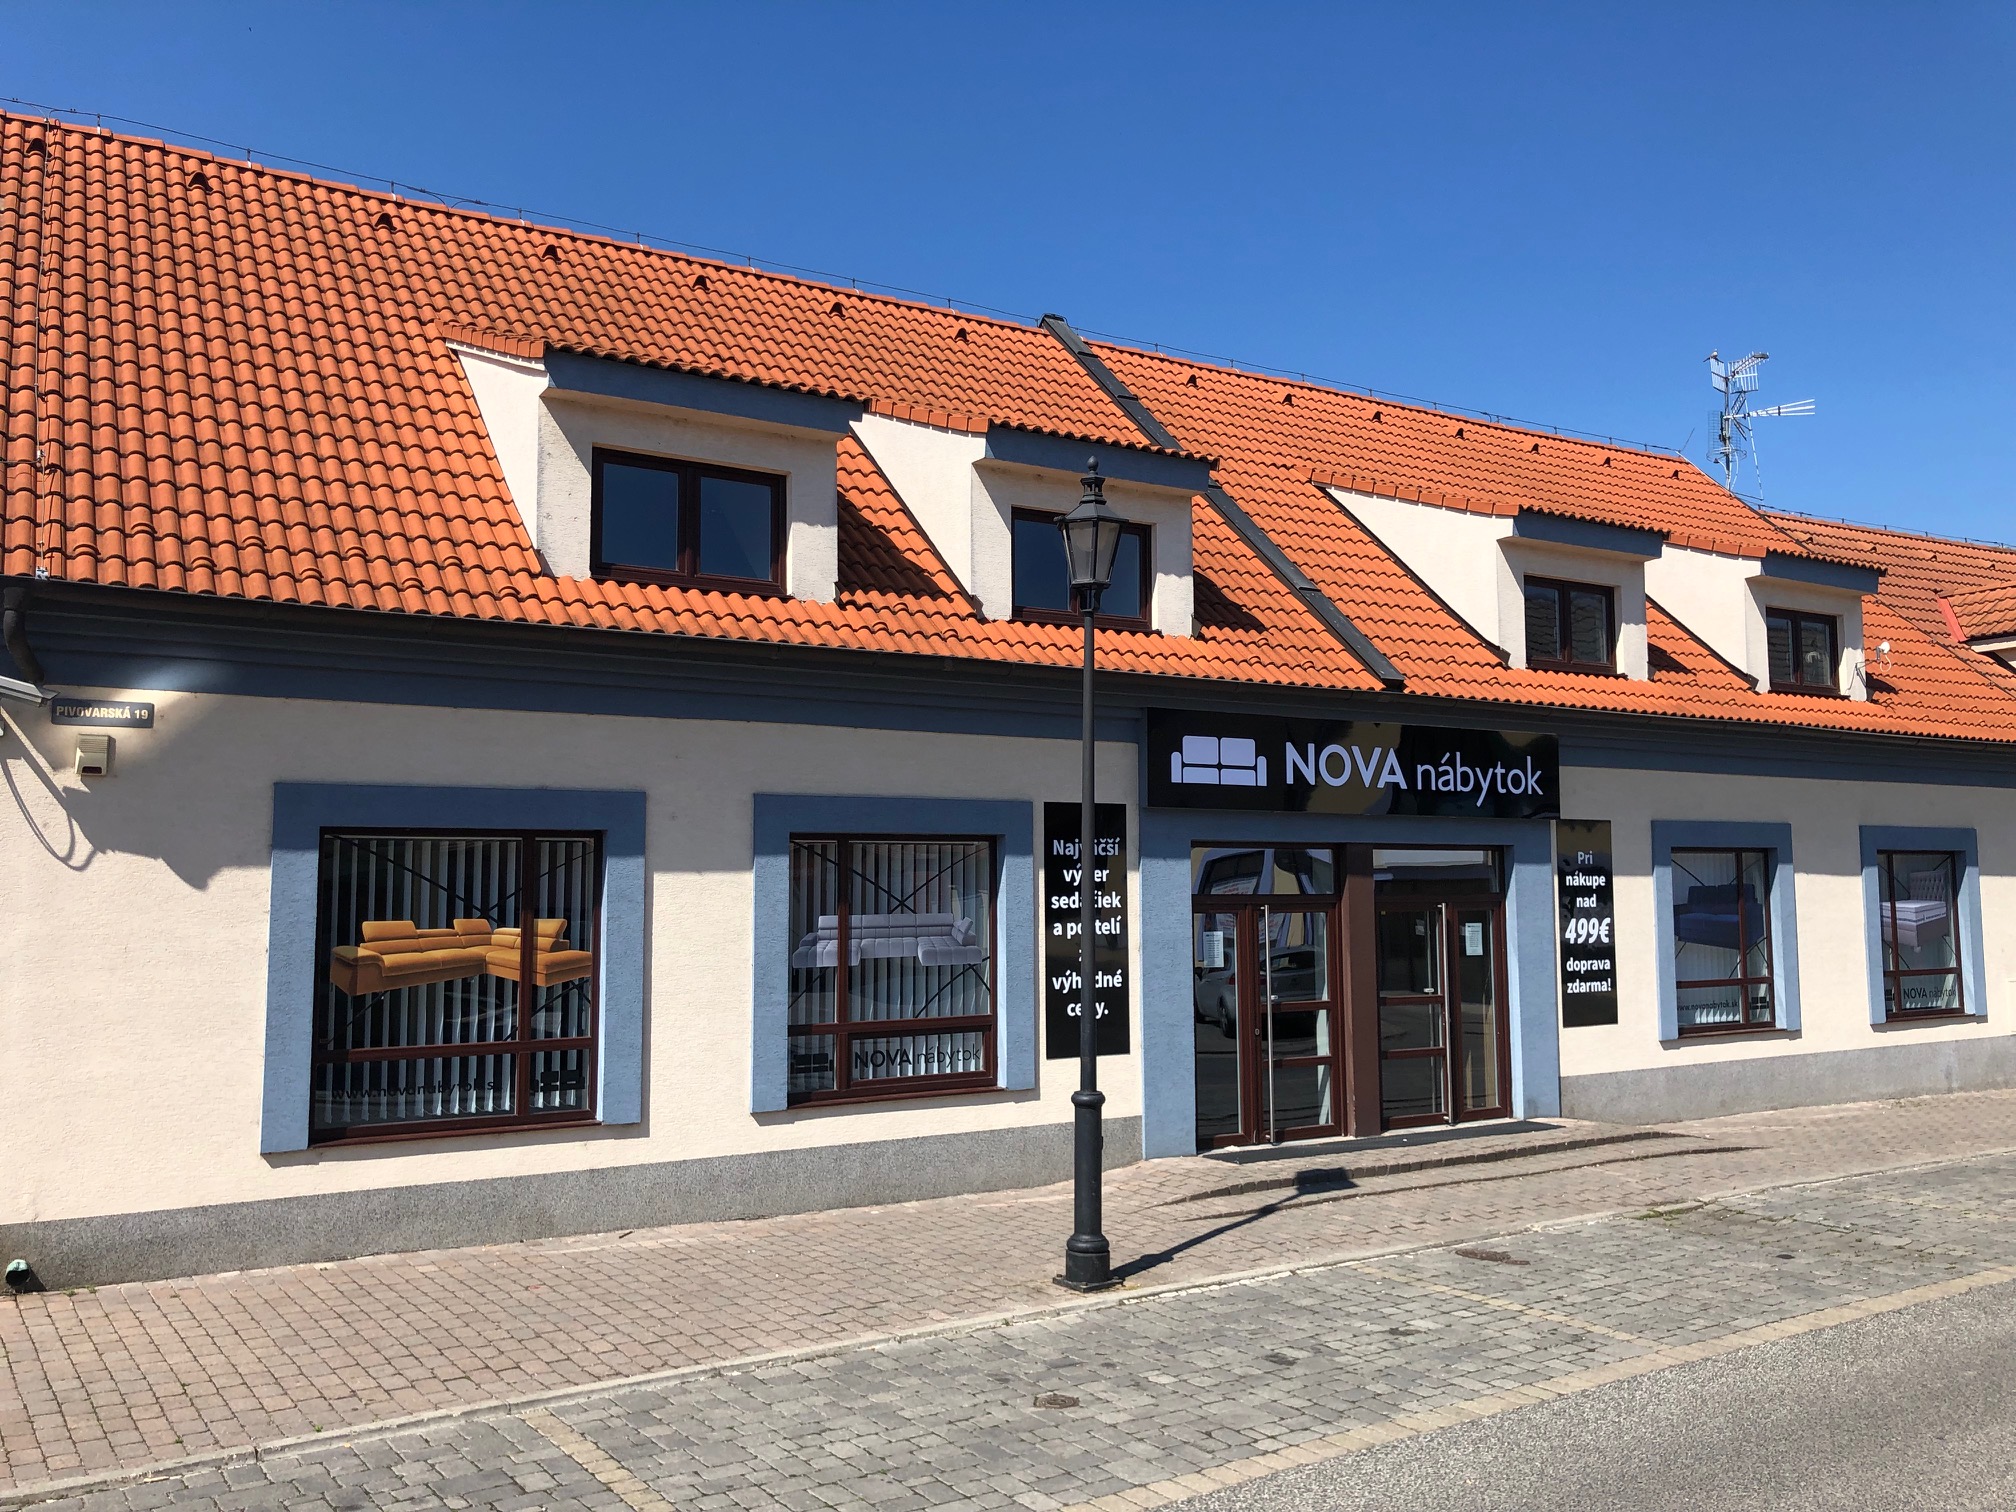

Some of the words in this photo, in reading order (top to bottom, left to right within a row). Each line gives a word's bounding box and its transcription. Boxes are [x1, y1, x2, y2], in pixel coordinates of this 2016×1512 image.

[56, 706, 131, 719] PIVOVARSKÁ
[135, 709, 149, 720] 19
[1286, 741, 1408, 790] NOVA
[1417, 751, 1544, 807] nábytok
[1053, 837, 1120, 859] Najčší
[1577, 851, 1593, 865] Pri
[1063, 863, 1109, 886] výer
[1566, 870, 1606, 889] nákupe
[1051, 890, 1121, 909] sediek
[1576, 894, 1597, 908] nad
[1053, 922, 1063, 936] a
[1067, 915, 1121, 939] ptelí
[1565, 917, 1611, 944] 499€
[1566, 957, 1611, 974] doprava
[1052, 969, 1123, 994] výhdné
[1567, 978, 1612, 993] zdarma!
[1903, 986, 1927, 1000] NOVA
[1067, 1002, 1109, 1019] cey.
[855, 1048, 912, 1070] NOVA
[917, 1043, 981, 1068] nábytok
